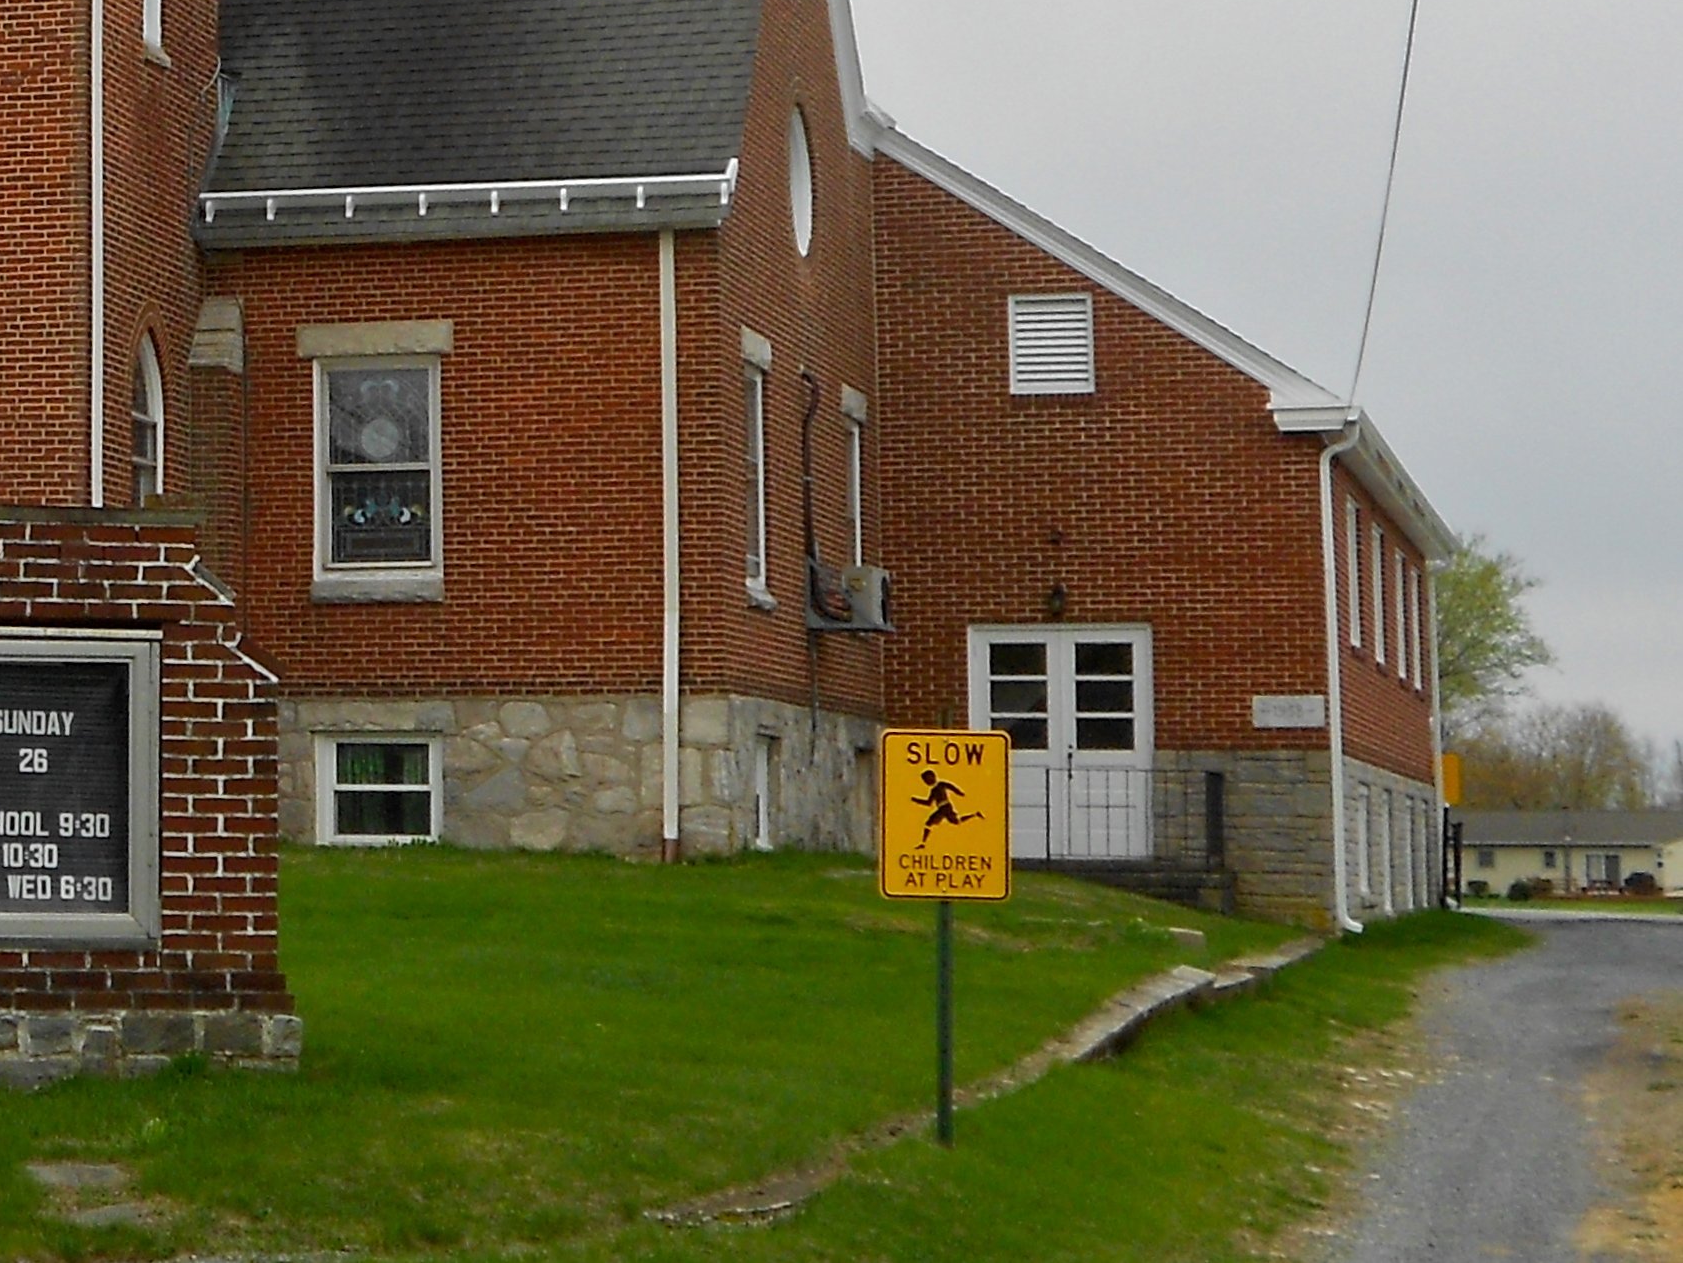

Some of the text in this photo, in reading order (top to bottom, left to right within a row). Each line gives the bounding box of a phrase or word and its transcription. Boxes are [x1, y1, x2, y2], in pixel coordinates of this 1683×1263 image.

[18, 747, 49, 774] 26
[906, 742, 985, 766] SLOW
[58, 812, 110, 838] 9:30
[2, 843, 59, 869] 10:30
[899, 854, 992, 871] CHILDREN
[6, 875, 52, 900] WED
[59, 875, 113, 901] 6:30
[905, 872, 986, 889] AT PLAY
